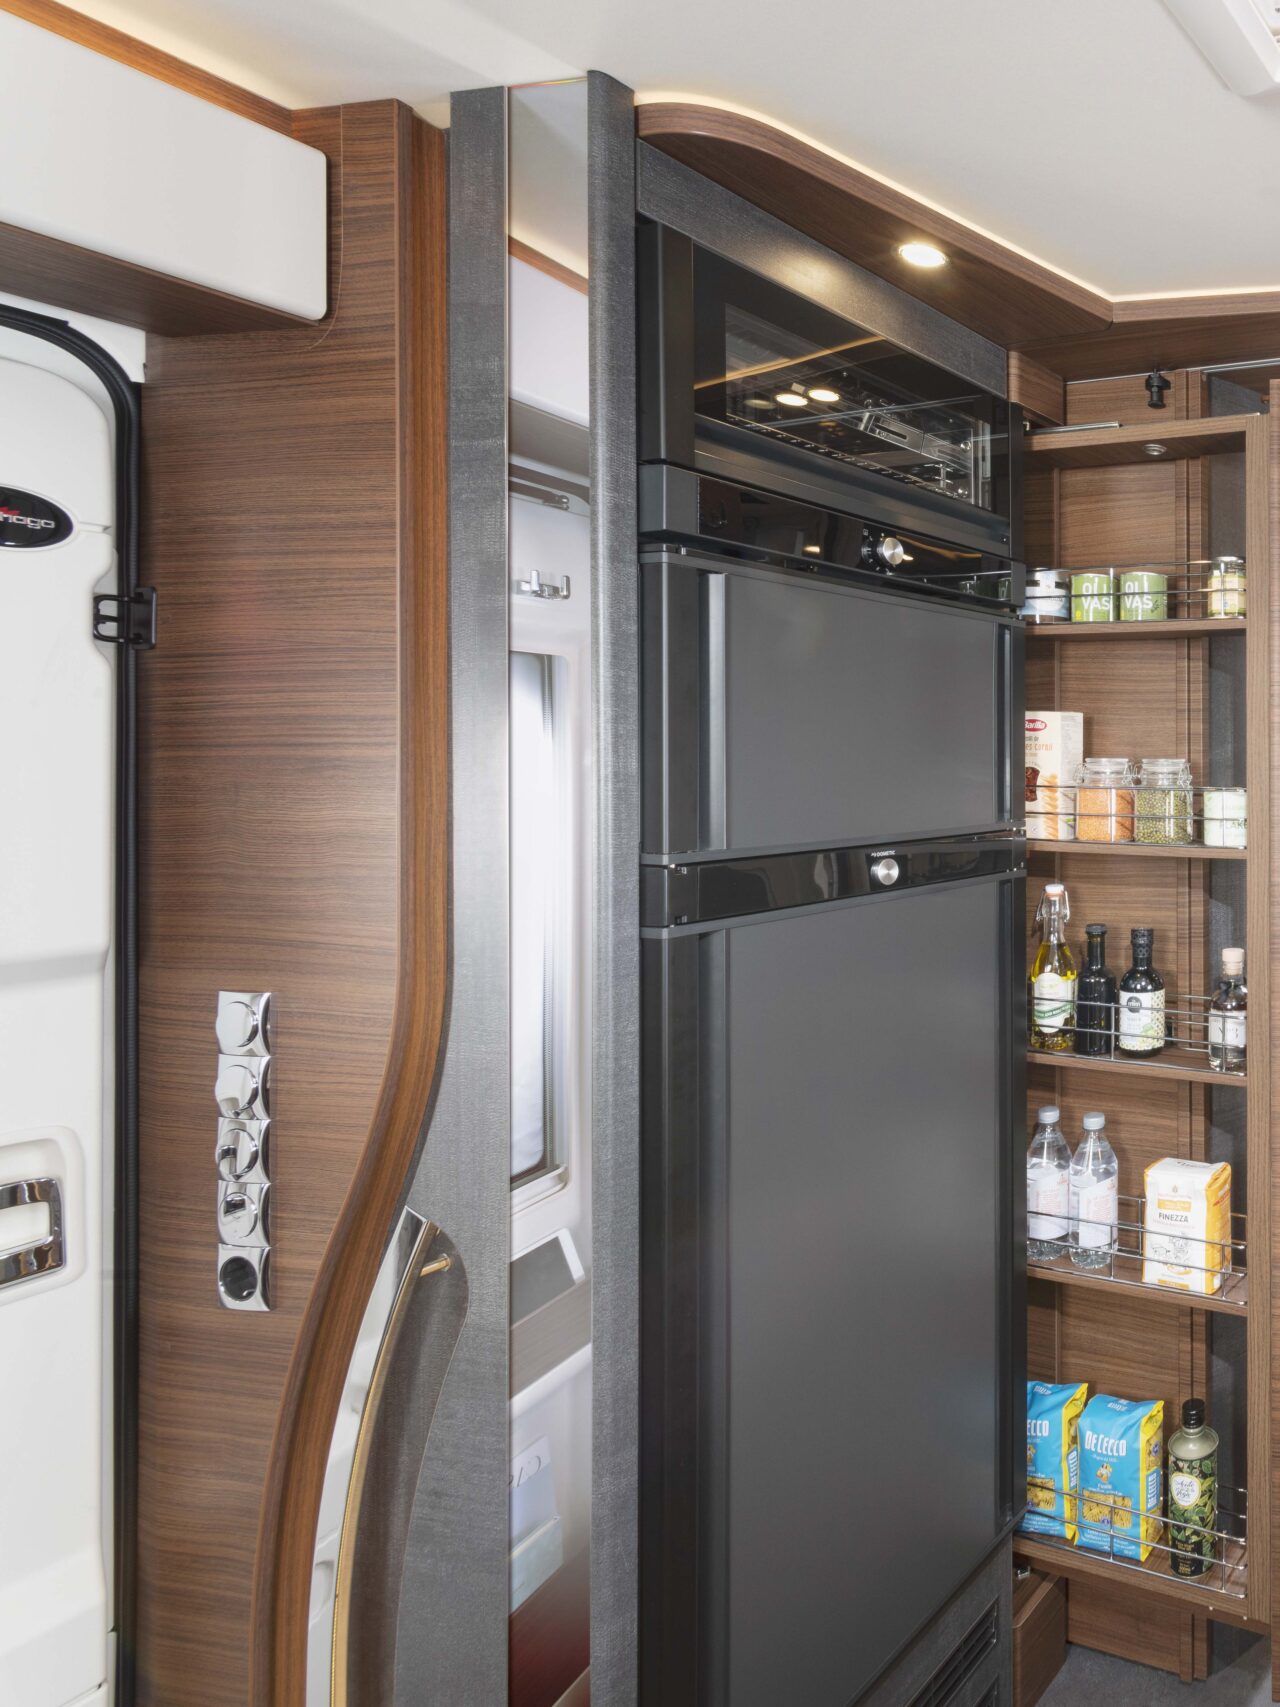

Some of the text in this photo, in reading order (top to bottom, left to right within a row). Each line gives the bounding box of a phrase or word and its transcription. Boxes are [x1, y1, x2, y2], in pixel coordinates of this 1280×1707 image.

[1082, 595, 1110, 610] VAS
[1125, 595, 1153, 609] VAS
[1158, 1212, 1189, 1223] FINEZZA
[1026, 1419, 1049, 1437] ECCO
[1085, 1430, 1127, 1457] DE CECCO
